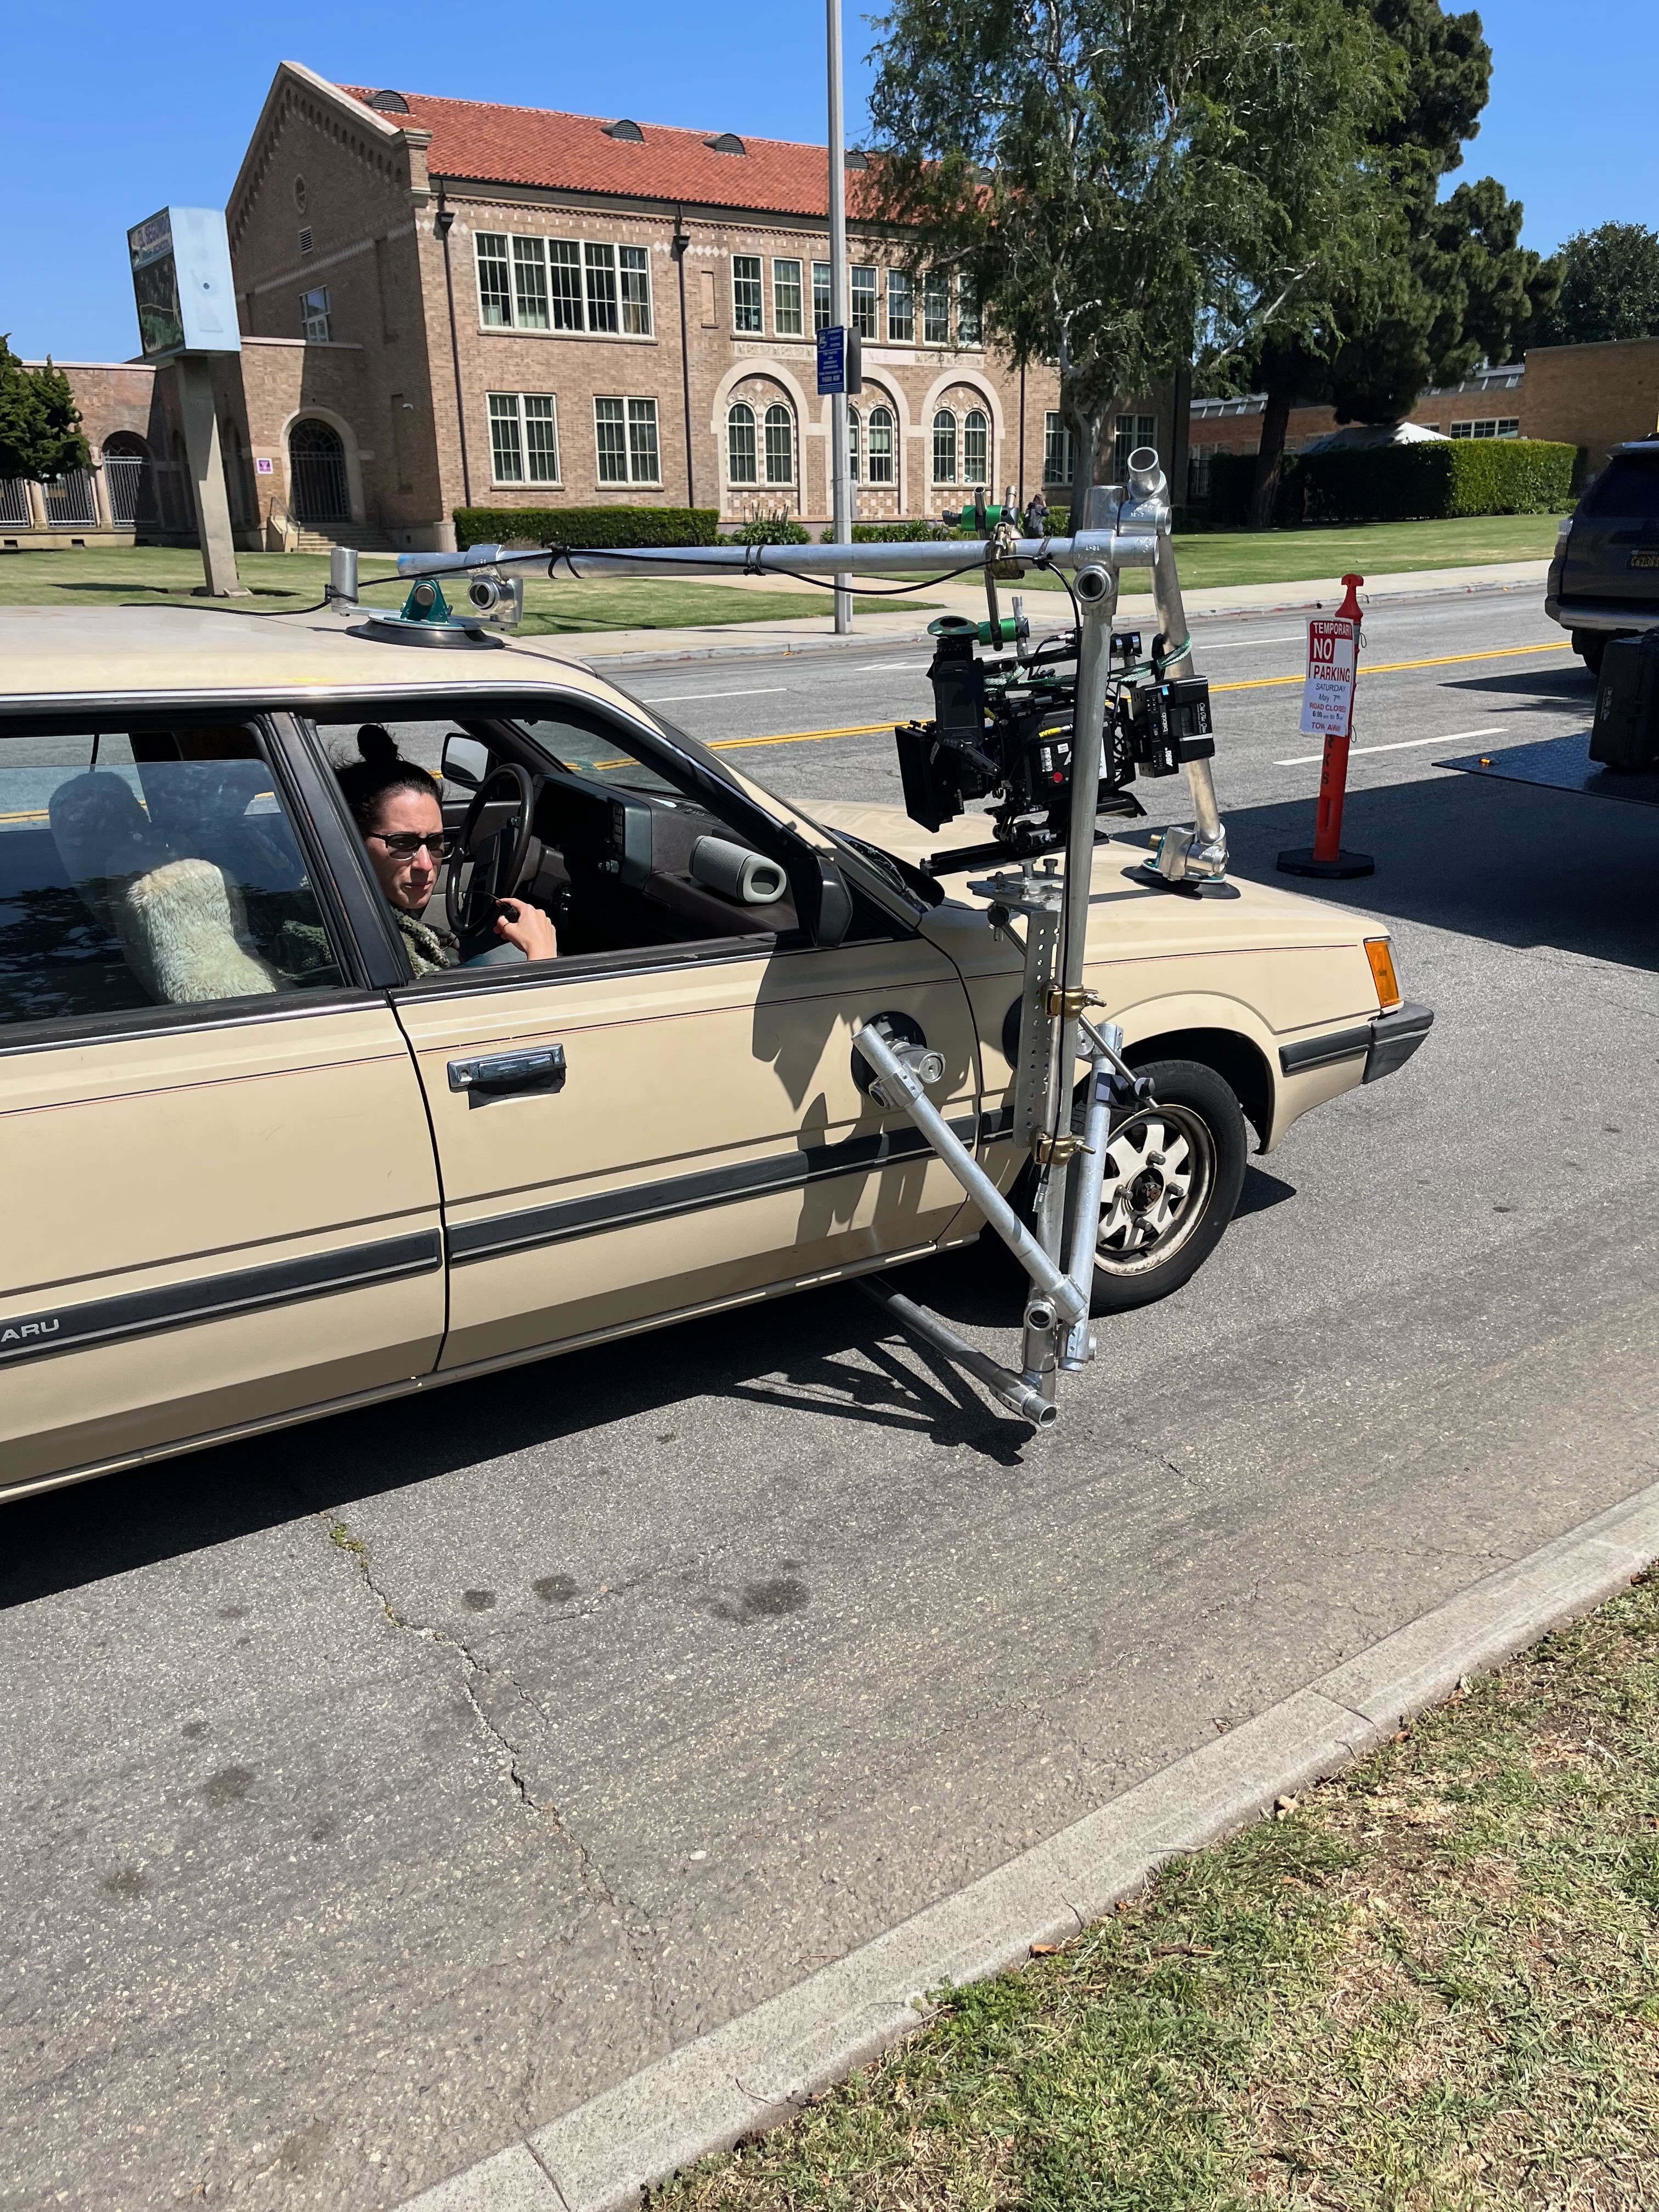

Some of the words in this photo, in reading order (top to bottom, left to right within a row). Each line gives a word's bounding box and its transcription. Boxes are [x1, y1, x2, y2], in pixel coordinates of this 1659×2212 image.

[1313, 638, 1333, 660] NO
[1313, 665, 1350, 682] PARKING
[1315, 683, 1346, 692] SATURDAY
[1309, 702, 1324, 710] ROAD
[1165, 750, 1173, 766] ARRI
[1, 1319, 59, 1342] ARU
